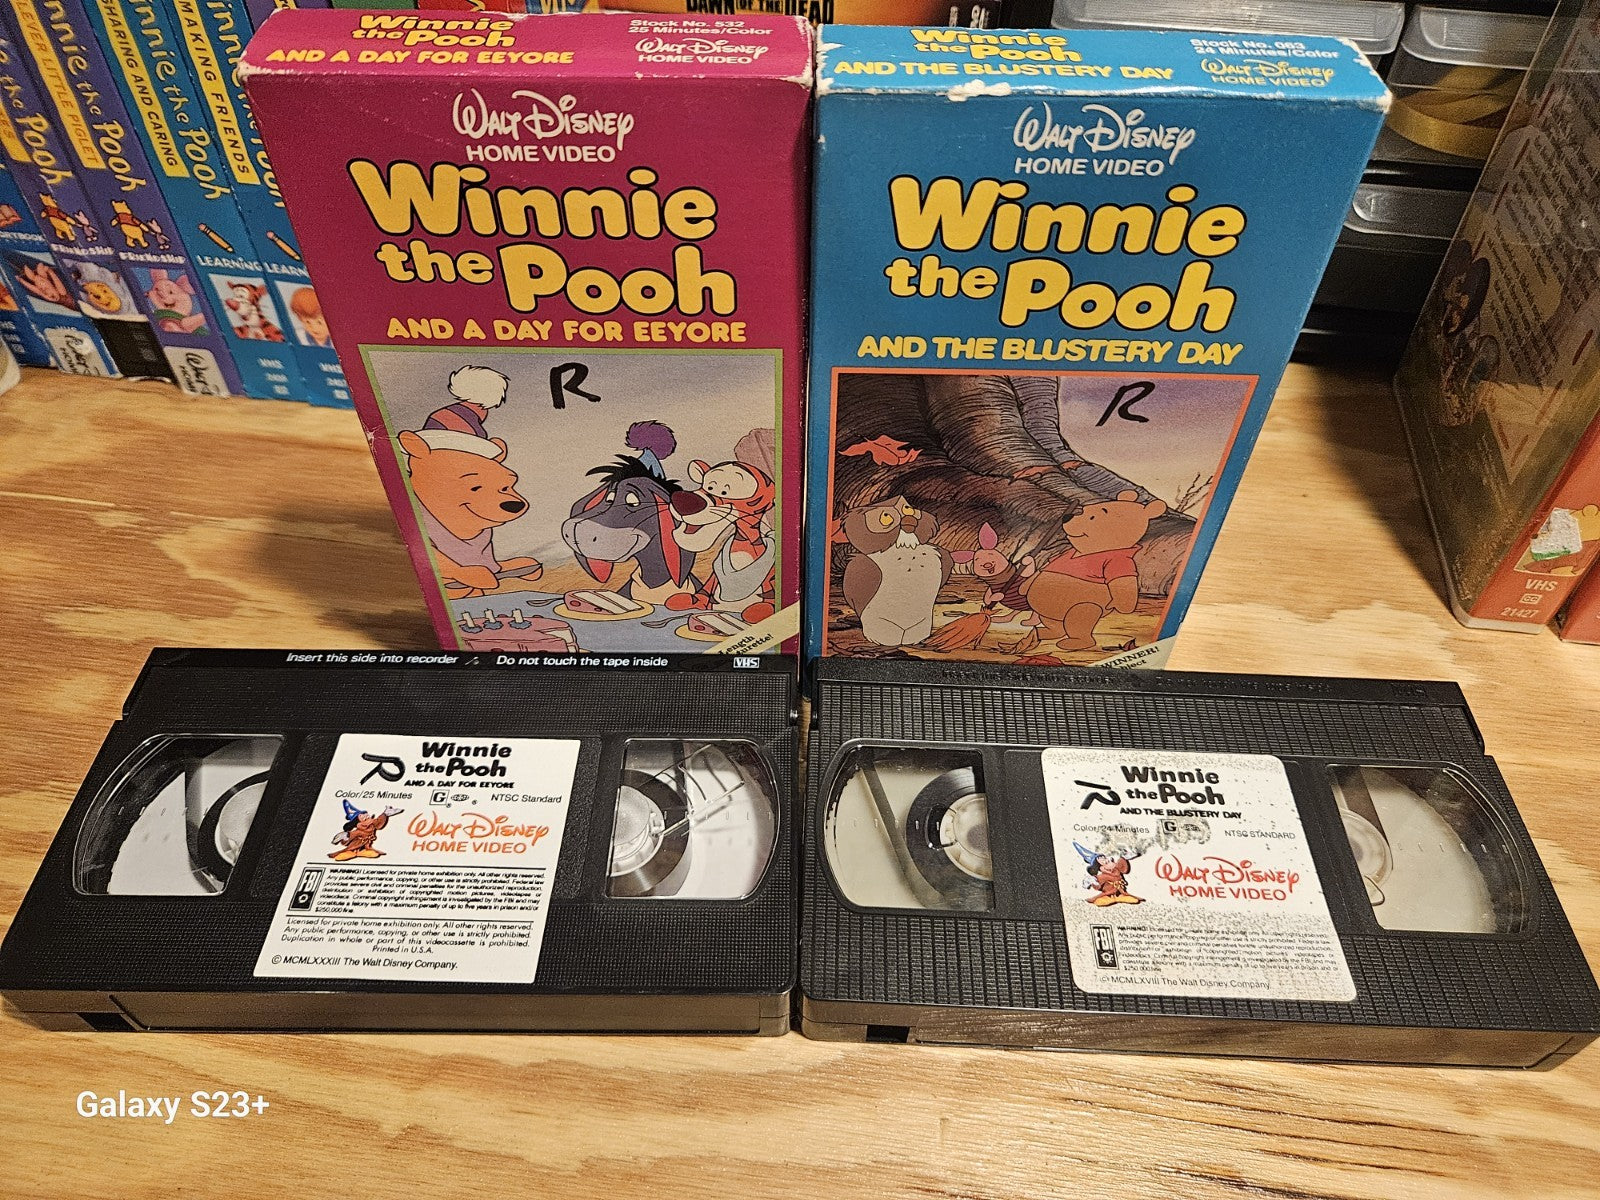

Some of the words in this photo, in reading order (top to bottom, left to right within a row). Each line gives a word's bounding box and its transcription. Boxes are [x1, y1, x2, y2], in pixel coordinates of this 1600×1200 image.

[360, 14, 515, 31] Winnie
[630, 19, 679, 27] Stock
[682, 20, 710, 28] No.
[714, 20, 745, 28] 532
[653, 27, 774, 36] Minutes/Color
[352, 28, 404, 40] the
[403, 29, 516, 48] Pooh
[910, 28, 1068, 46] Winnie
[1189, 38, 1241, 49] Stock
[1242, 40, 1273, 49] No.
[265, 49, 326, 63] AND
[329, 51, 351, 63] A
[357, 51, 411, 63] DAY
[417, 51, 470, 64] FOR
[476, 51, 575, 65] EEYORE
[638, 54, 694, 63] HOME
[696, 55, 753, 65] VIDEO
[913, 42, 967, 54] the
[968, 44, 1082, 62] Pooh
[1217, 47, 1341, 58] Minutes/Color
[834, 61, 897, 75] AND
[899, 62, 959, 76] THE
[964, 63, 1112, 78] BLUSTERY
[1119, 65, 1174, 80] DAY
[179, 0, 216, 82] MAKING
[211, 92, 250, 174] FRIENDS
[1210, 75, 1267, 85] HOME
[1267, 76, 1327, 87] VIDEO
[43, 57, 74, 110] LITTLE
[68, 113, 99, 164] PIGLET
[131, 74, 153, 107] AND
[147, 111, 178, 168] CARING
[76, 79, 102, 116] the
[92, 119, 146, 193] Pooh
[162, 84, 191, 124] the
[178, 126, 231, 200] Pooh
[15, 112, 73, 186] Pooh
[466, 144, 540, 162] HOME
[543, 145, 616, 164] VIDEO
[1014, 157, 1088, 175] HOME
[1093, 158, 1165, 176] VIDEO
[348, 158, 718, 242] Winnie
[888, 173, 1247, 258] Winnie
[198, 254, 263, 273] LEARNING
[375, 239, 496, 285] the
[497, 241, 738, 318] Pooh
[883, 254, 999, 299] the
[998, 256, 1237, 333] Pooh
[387, 316, 455, 340] AND
[463, 317, 488, 341] A
[493, 318, 553, 342] DAY
[562, 319, 625, 342] FOR
[634, 320, 748, 344] EEYORE
[857, 335, 928, 359] AND
[932, 335, 998, 361] THE
[1001, 337, 1174, 363] BLUSTERY
[1176, 341, 1244, 366] DAY
[548, 360, 602, 410] R
[1094, 380, 1156, 427] R
[1525, 578, 1558, 591] VHS
[1501, 607, 1539, 618] 21427
[286, 652, 323, 662] Insert
[326, 653, 348, 663] this
[351, 653, 377, 663] side
[379, 653, 403, 663] into
[406, 654, 459, 664] recorder
[496, 655, 515, 666] Do
[518, 656, 539, 666] not
[543, 655, 577, 666] touch
[580, 656, 600, 666] the
[603, 656, 629, 668] tape
[632, 656, 668, 666] inside
[735, 657, 759, 668] VHS
[421, 741, 513, 758] Winnie
[360, 752, 406, 786] R
[415, 762, 444, 774] the
[446, 757, 507, 777] Pooh
[1120, 765, 1220, 785] Winnie
[335, 790, 375, 799] Color/25
[377, 790, 413, 800] Minutes
[431, 791, 447, 803] G
[490, 793, 519, 802] NTSC
[521, 794, 562, 803] Standard
[1126, 788, 1158, 801] the
[1158, 783, 1226, 806] Pooh
[1119, 807, 1142, 815] AND
[1144, 808, 1164, 816] THE
[1166, 808, 1220, 818] BLUSTERY
[1222, 810, 1243, 820] DAY
[1224, 830, 1249, 838] NTSC
[1249, 831, 1296, 840] STANDARD
[412, 840, 468, 853] HOME
[472, 841, 528, 854] VIDEO
[1169, 885, 1227, 898] HOME
[1228, 887, 1287, 901] VIDEO
[287, 917, 319, 925] Licensed
[332, 919, 359, 927] private
[383, 919, 422, 927] exhibition
[455, 921, 475, 929] other
[476, 922, 498, 930] rights
[372, 944, 401, 953] Printed
[411, 946, 434, 954] U.S.A.
[344, 957, 360, 966] The
[362, 957, 381, 967] Walt
[383, 958, 413, 970] Disney
[414, 959, 458, 971] Company.
[1161, 977, 1178, 986] The
[1178, 978, 1199, 986] Walt
[1199, 979, 1228, 988] Disney
